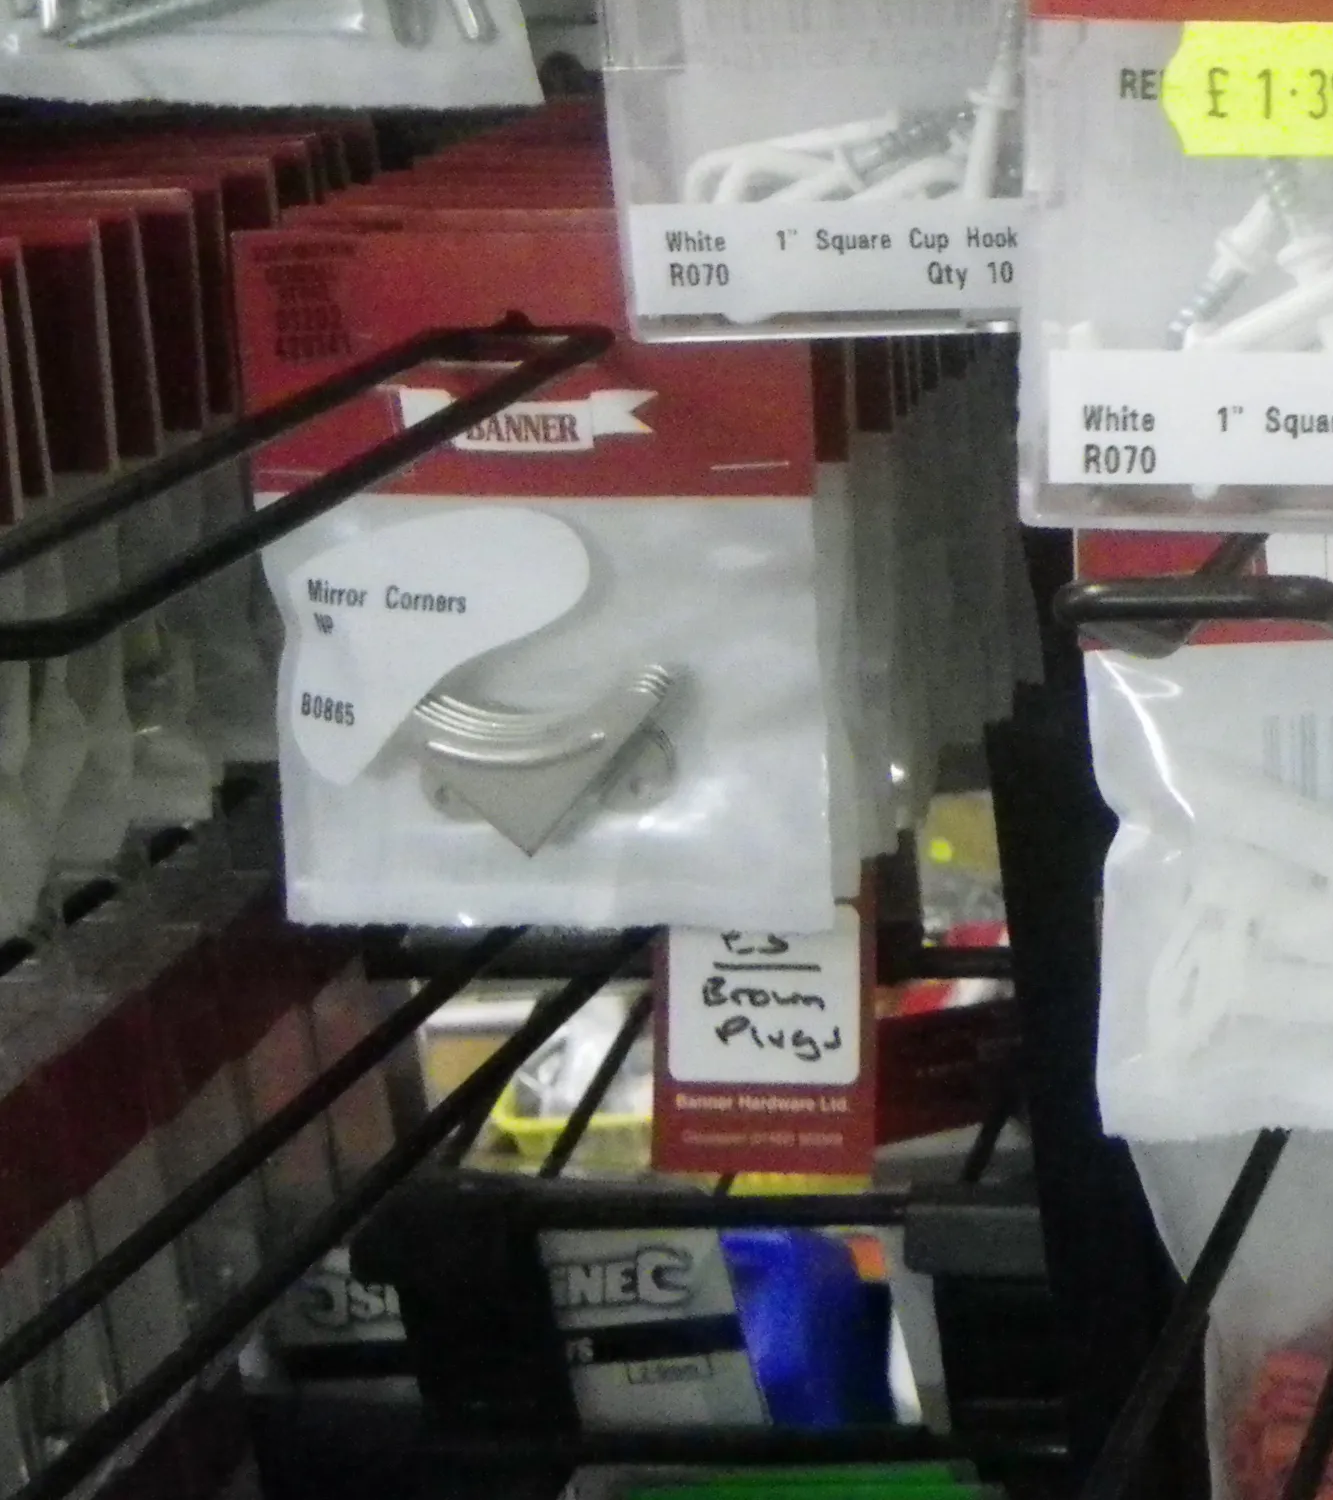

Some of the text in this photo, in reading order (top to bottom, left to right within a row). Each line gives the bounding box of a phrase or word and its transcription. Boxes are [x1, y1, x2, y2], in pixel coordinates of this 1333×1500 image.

[665, 230, 726, 253] White
[815, 229, 893, 255] Square
[908, 227, 951, 253] Cup
[967, 226, 1019, 249] Hook
[669, 262, 730, 287] R070
[926, 261, 1014, 290] Qty 10
[466, 412, 580, 444] BANNER
[1082, 404, 1156, 433] White
[1083, 444, 1157, 475] R070
[307, 578, 467, 614] Mirror Corners
